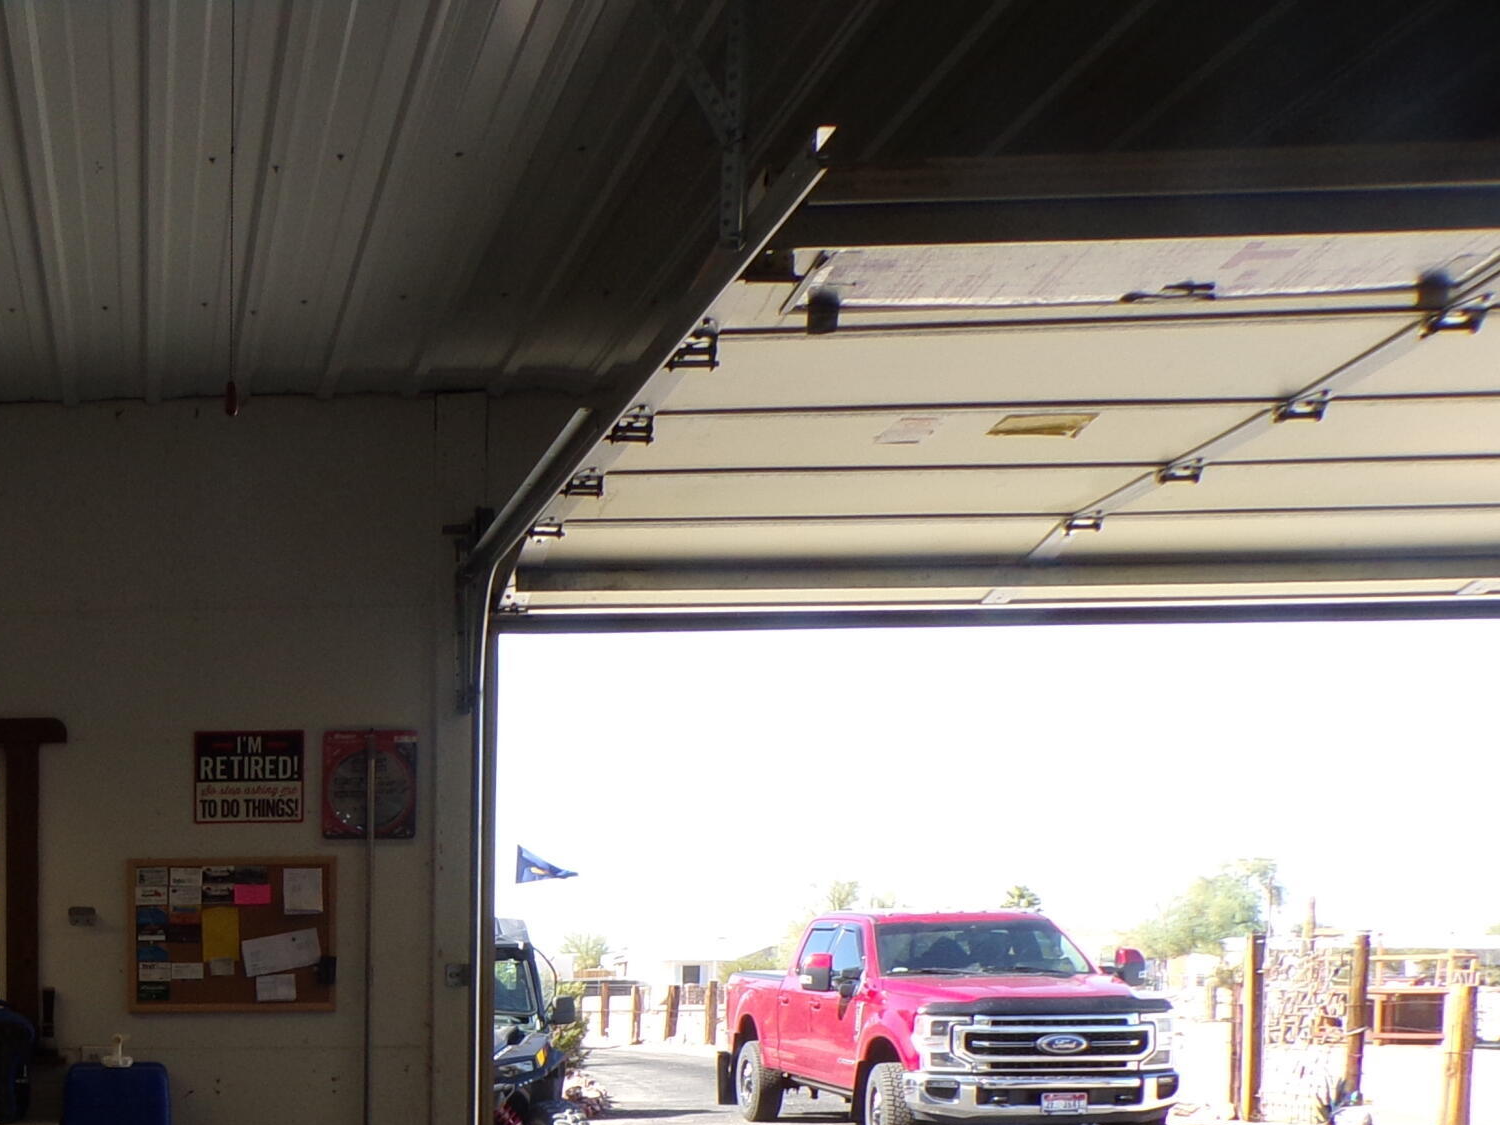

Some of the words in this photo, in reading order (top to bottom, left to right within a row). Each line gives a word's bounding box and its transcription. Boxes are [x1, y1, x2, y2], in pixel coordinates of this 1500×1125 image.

[236, 735, 263, 754] I'M
[199, 755, 300, 780] RETIRED!
[199, 798, 217, 818] TO
[220, 798, 240, 818] DO
[243, 798, 299, 818] THINGS!
